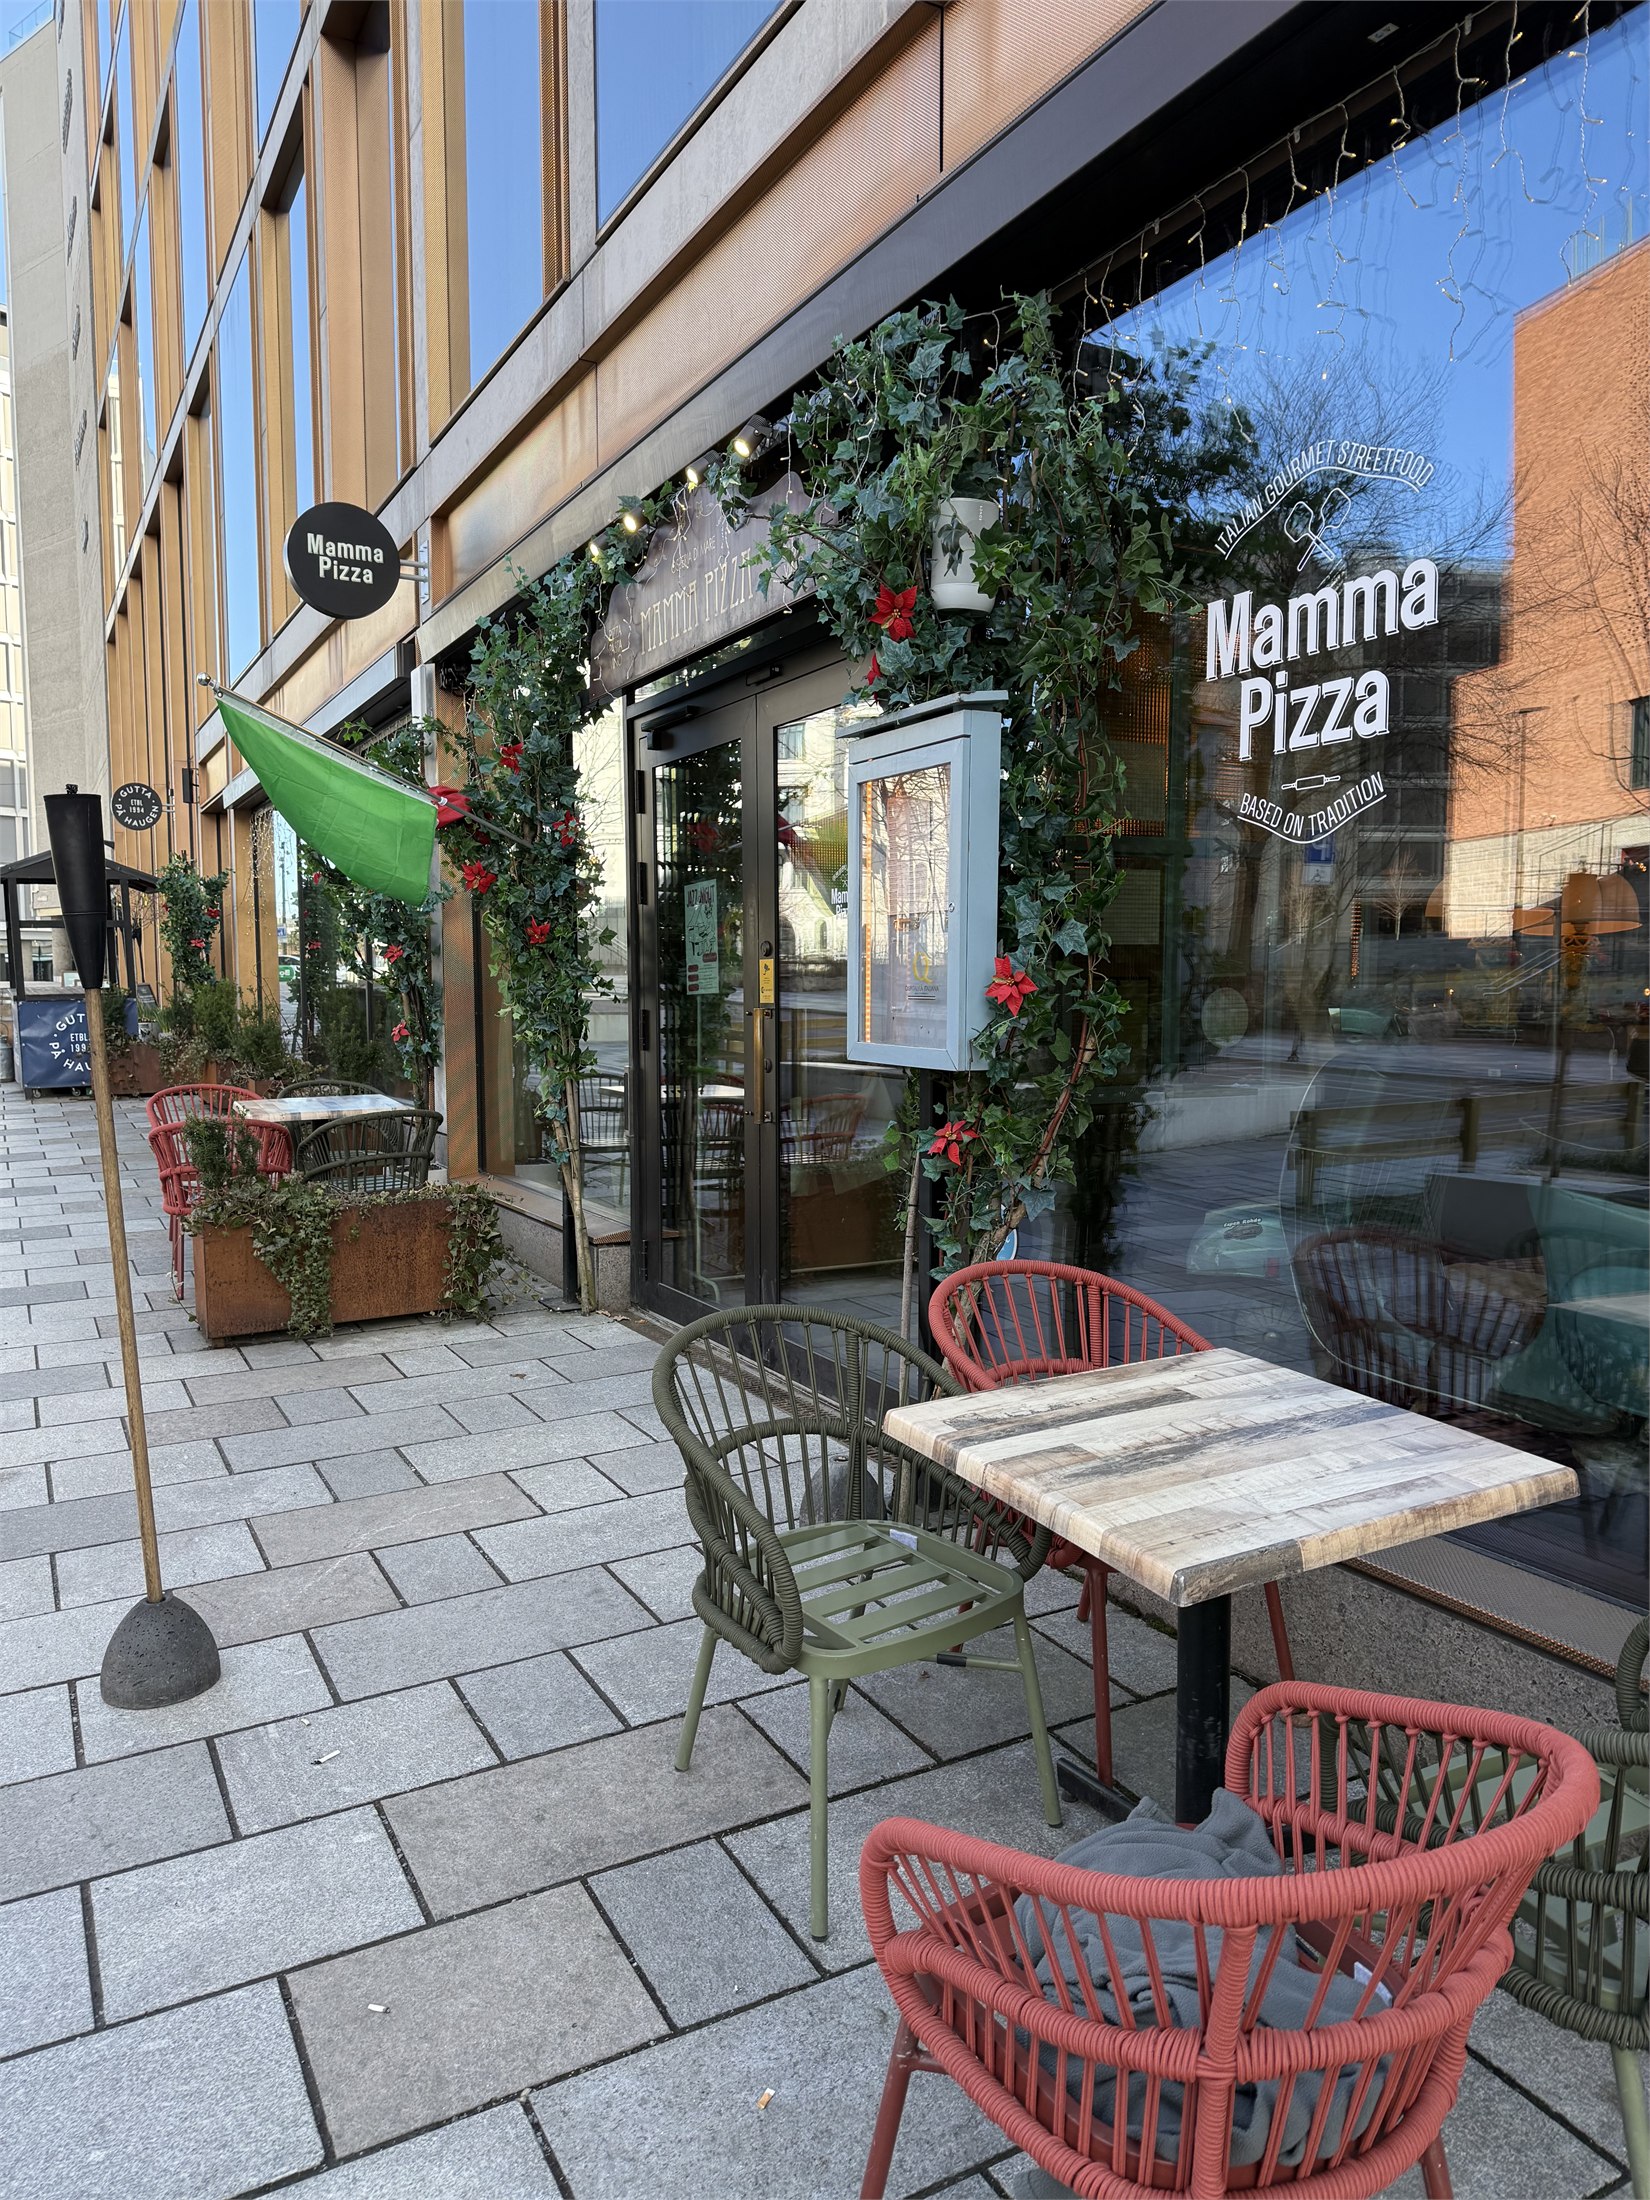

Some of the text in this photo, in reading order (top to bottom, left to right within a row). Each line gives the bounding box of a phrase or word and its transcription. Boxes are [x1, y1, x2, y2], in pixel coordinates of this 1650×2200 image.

[1214, 440, 1435, 555] ITALIAN GOURMET STREETFOOD
[307, 532, 384, 564] Mamma
[319, 556, 374, 584] Pizza
[640, 548, 754, 655] MAMMA PIZZA
[1205, 558, 1439, 682] Mamma
[1239, 670, 1390, 762] Pizza
[120, 785, 152, 799] GUTTA
[1239, 771, 1384, 837] BASED ON TRADITION
[115, 804, 159, 827] PÅ HAUGEN
[56, 1013, 86, 1031] GUT
[49, 1042, 65, 1059] PÅ
[70, 1044, 91, 1053] 199
